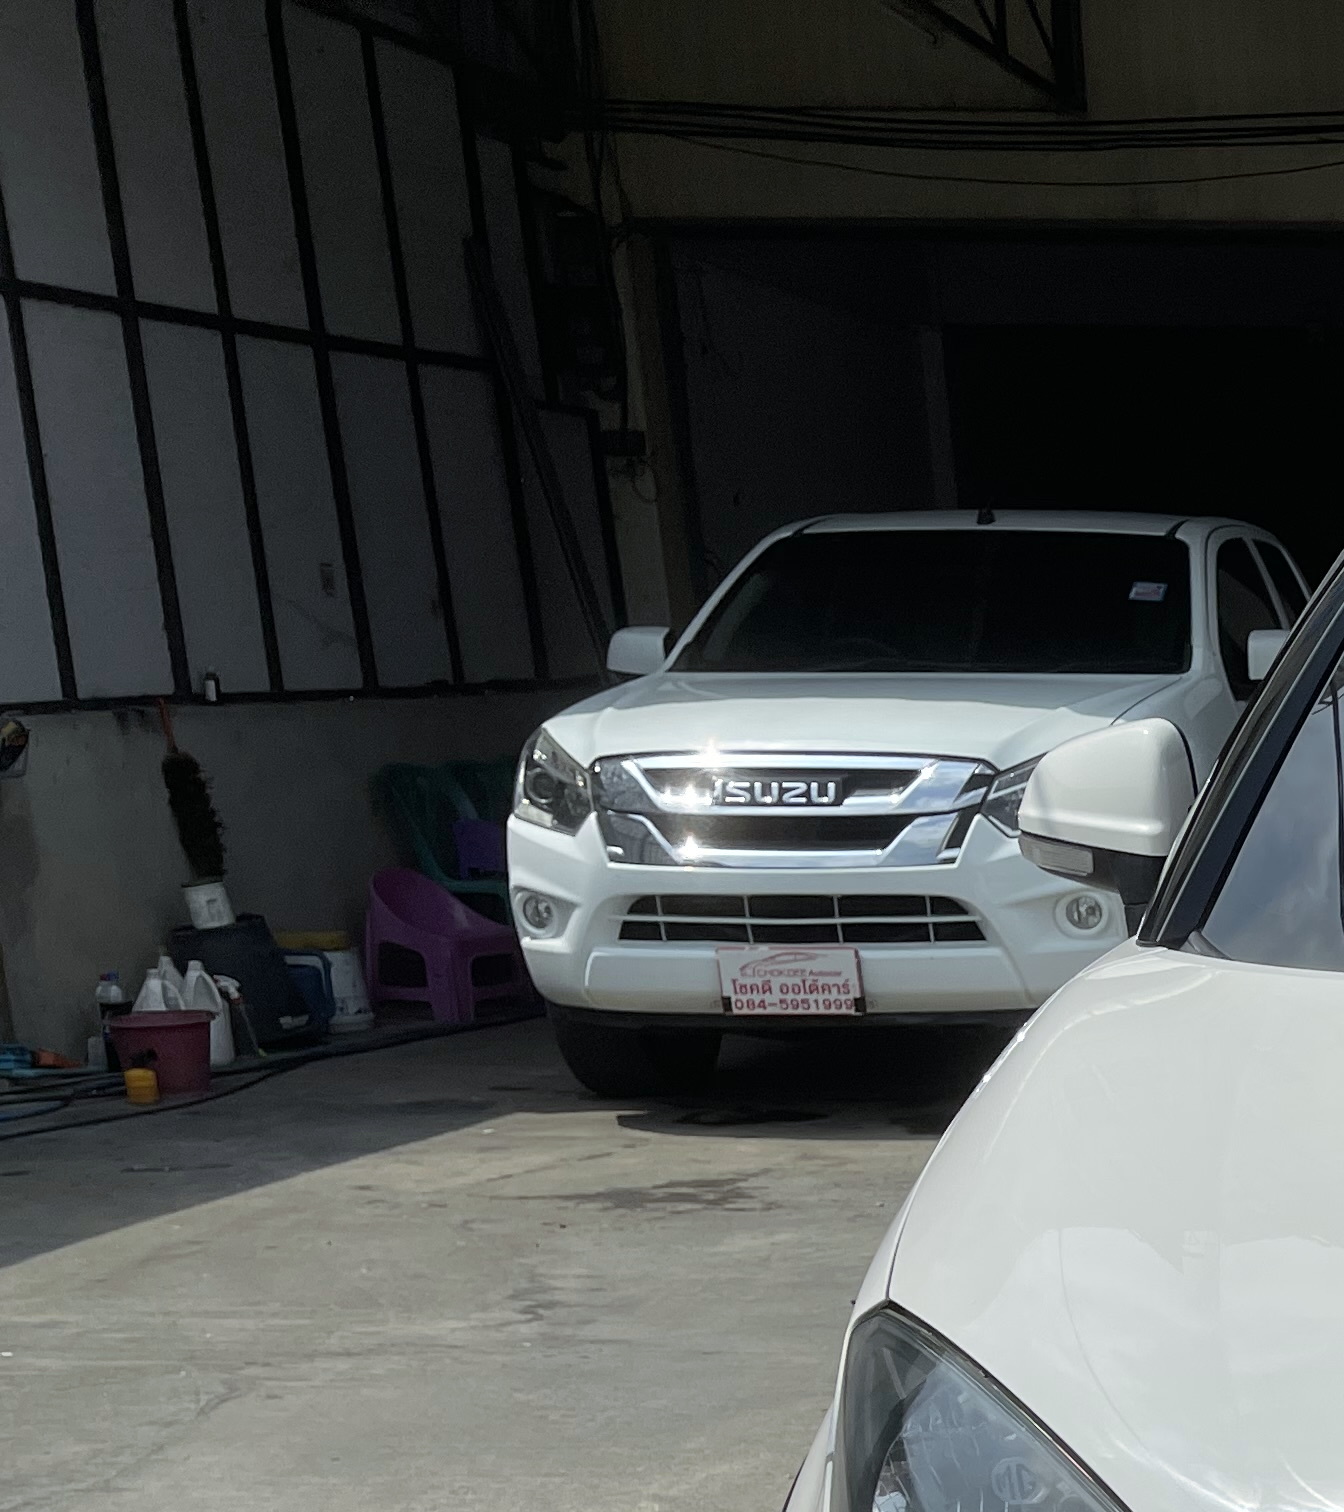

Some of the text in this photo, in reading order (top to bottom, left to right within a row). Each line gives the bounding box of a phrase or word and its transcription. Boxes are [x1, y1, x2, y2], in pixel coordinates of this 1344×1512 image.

[713, 779, 836, 804] ISUZU
[732, 978, 772, 995] โชคดี
[735, 999, 854, 1010] 084-5951999
